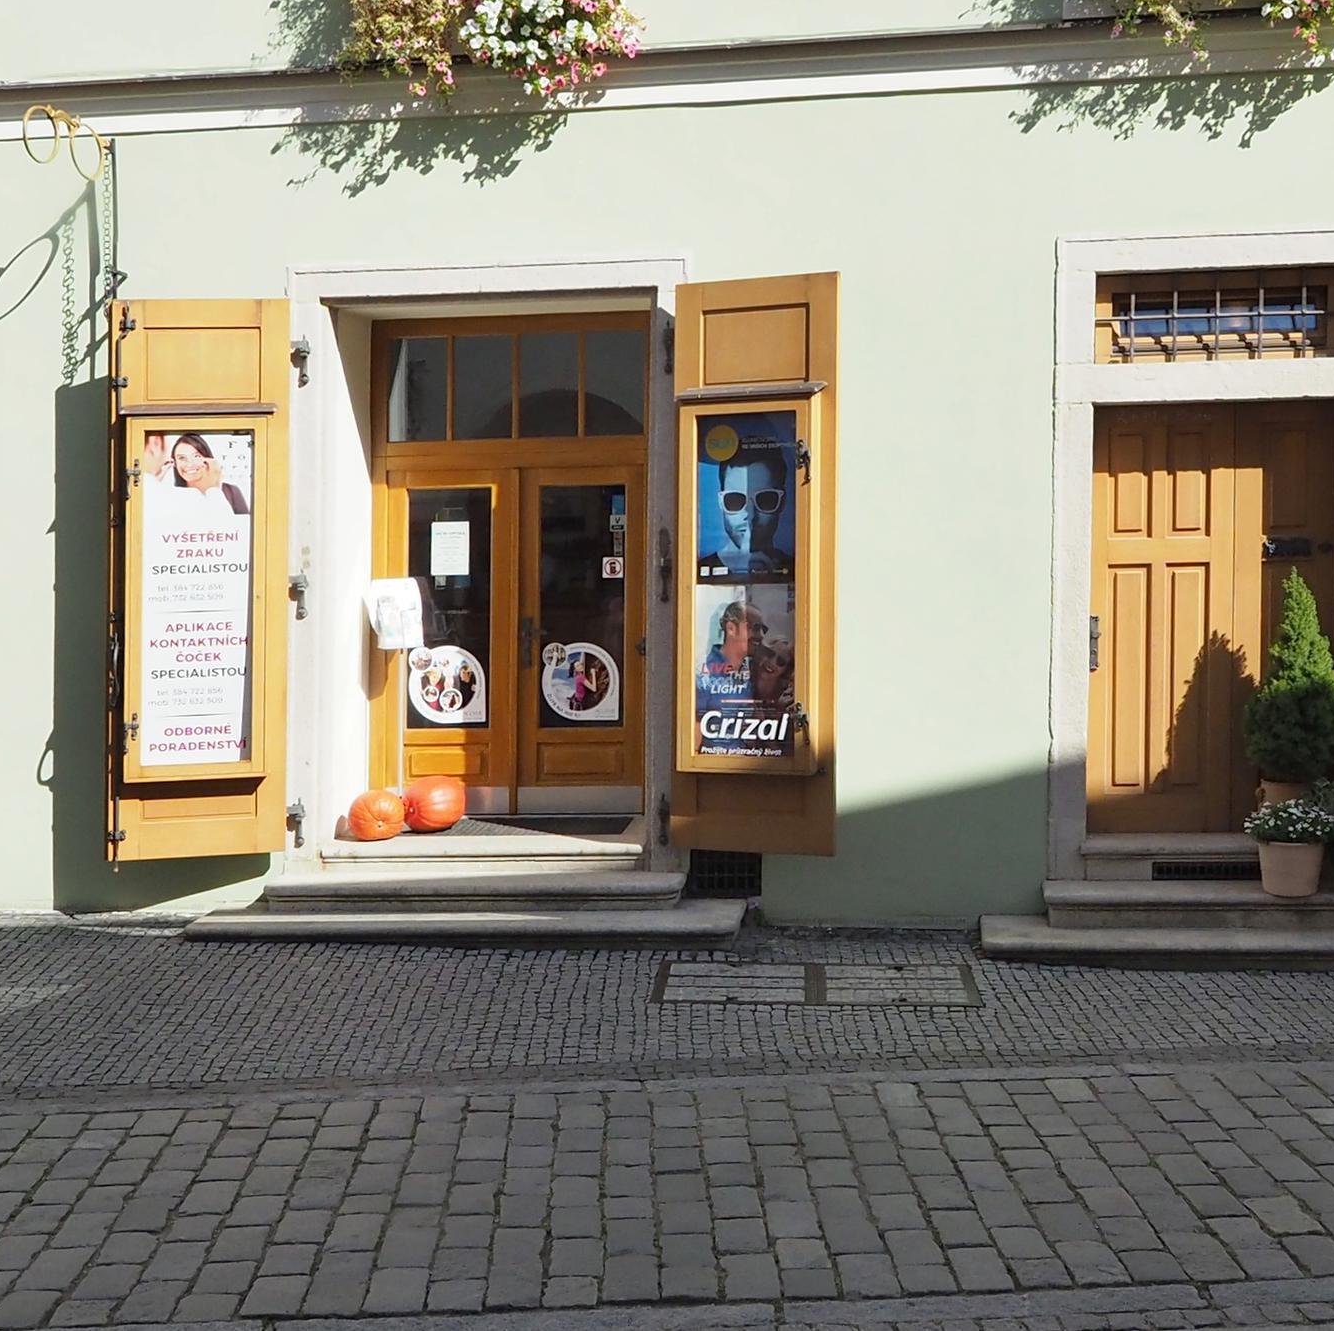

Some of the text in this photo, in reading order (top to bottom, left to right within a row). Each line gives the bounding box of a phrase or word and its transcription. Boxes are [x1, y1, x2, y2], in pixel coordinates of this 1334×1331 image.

[162, 530, 239, 543] VYŠETŘENÍ
[176, 548, 224, 559] ZRAKU
[152, 563, 248, 575] SPECIALISTOU
[165, 621, 233, 633] APLIKACE
[150, 635, 248, 648] KONTAKTNÍCH
[176, 650, 222, 662] ČOČEK
[151, 666, 247, 679] SPECIALISTOU
[710, 684, 745, 694] LIGHT
[164, 722, 231, 736] ODBORNÉ
[700, 710, 789, 740] Crizal
[149, 736, 247, 752] PORADENSTVÍ
